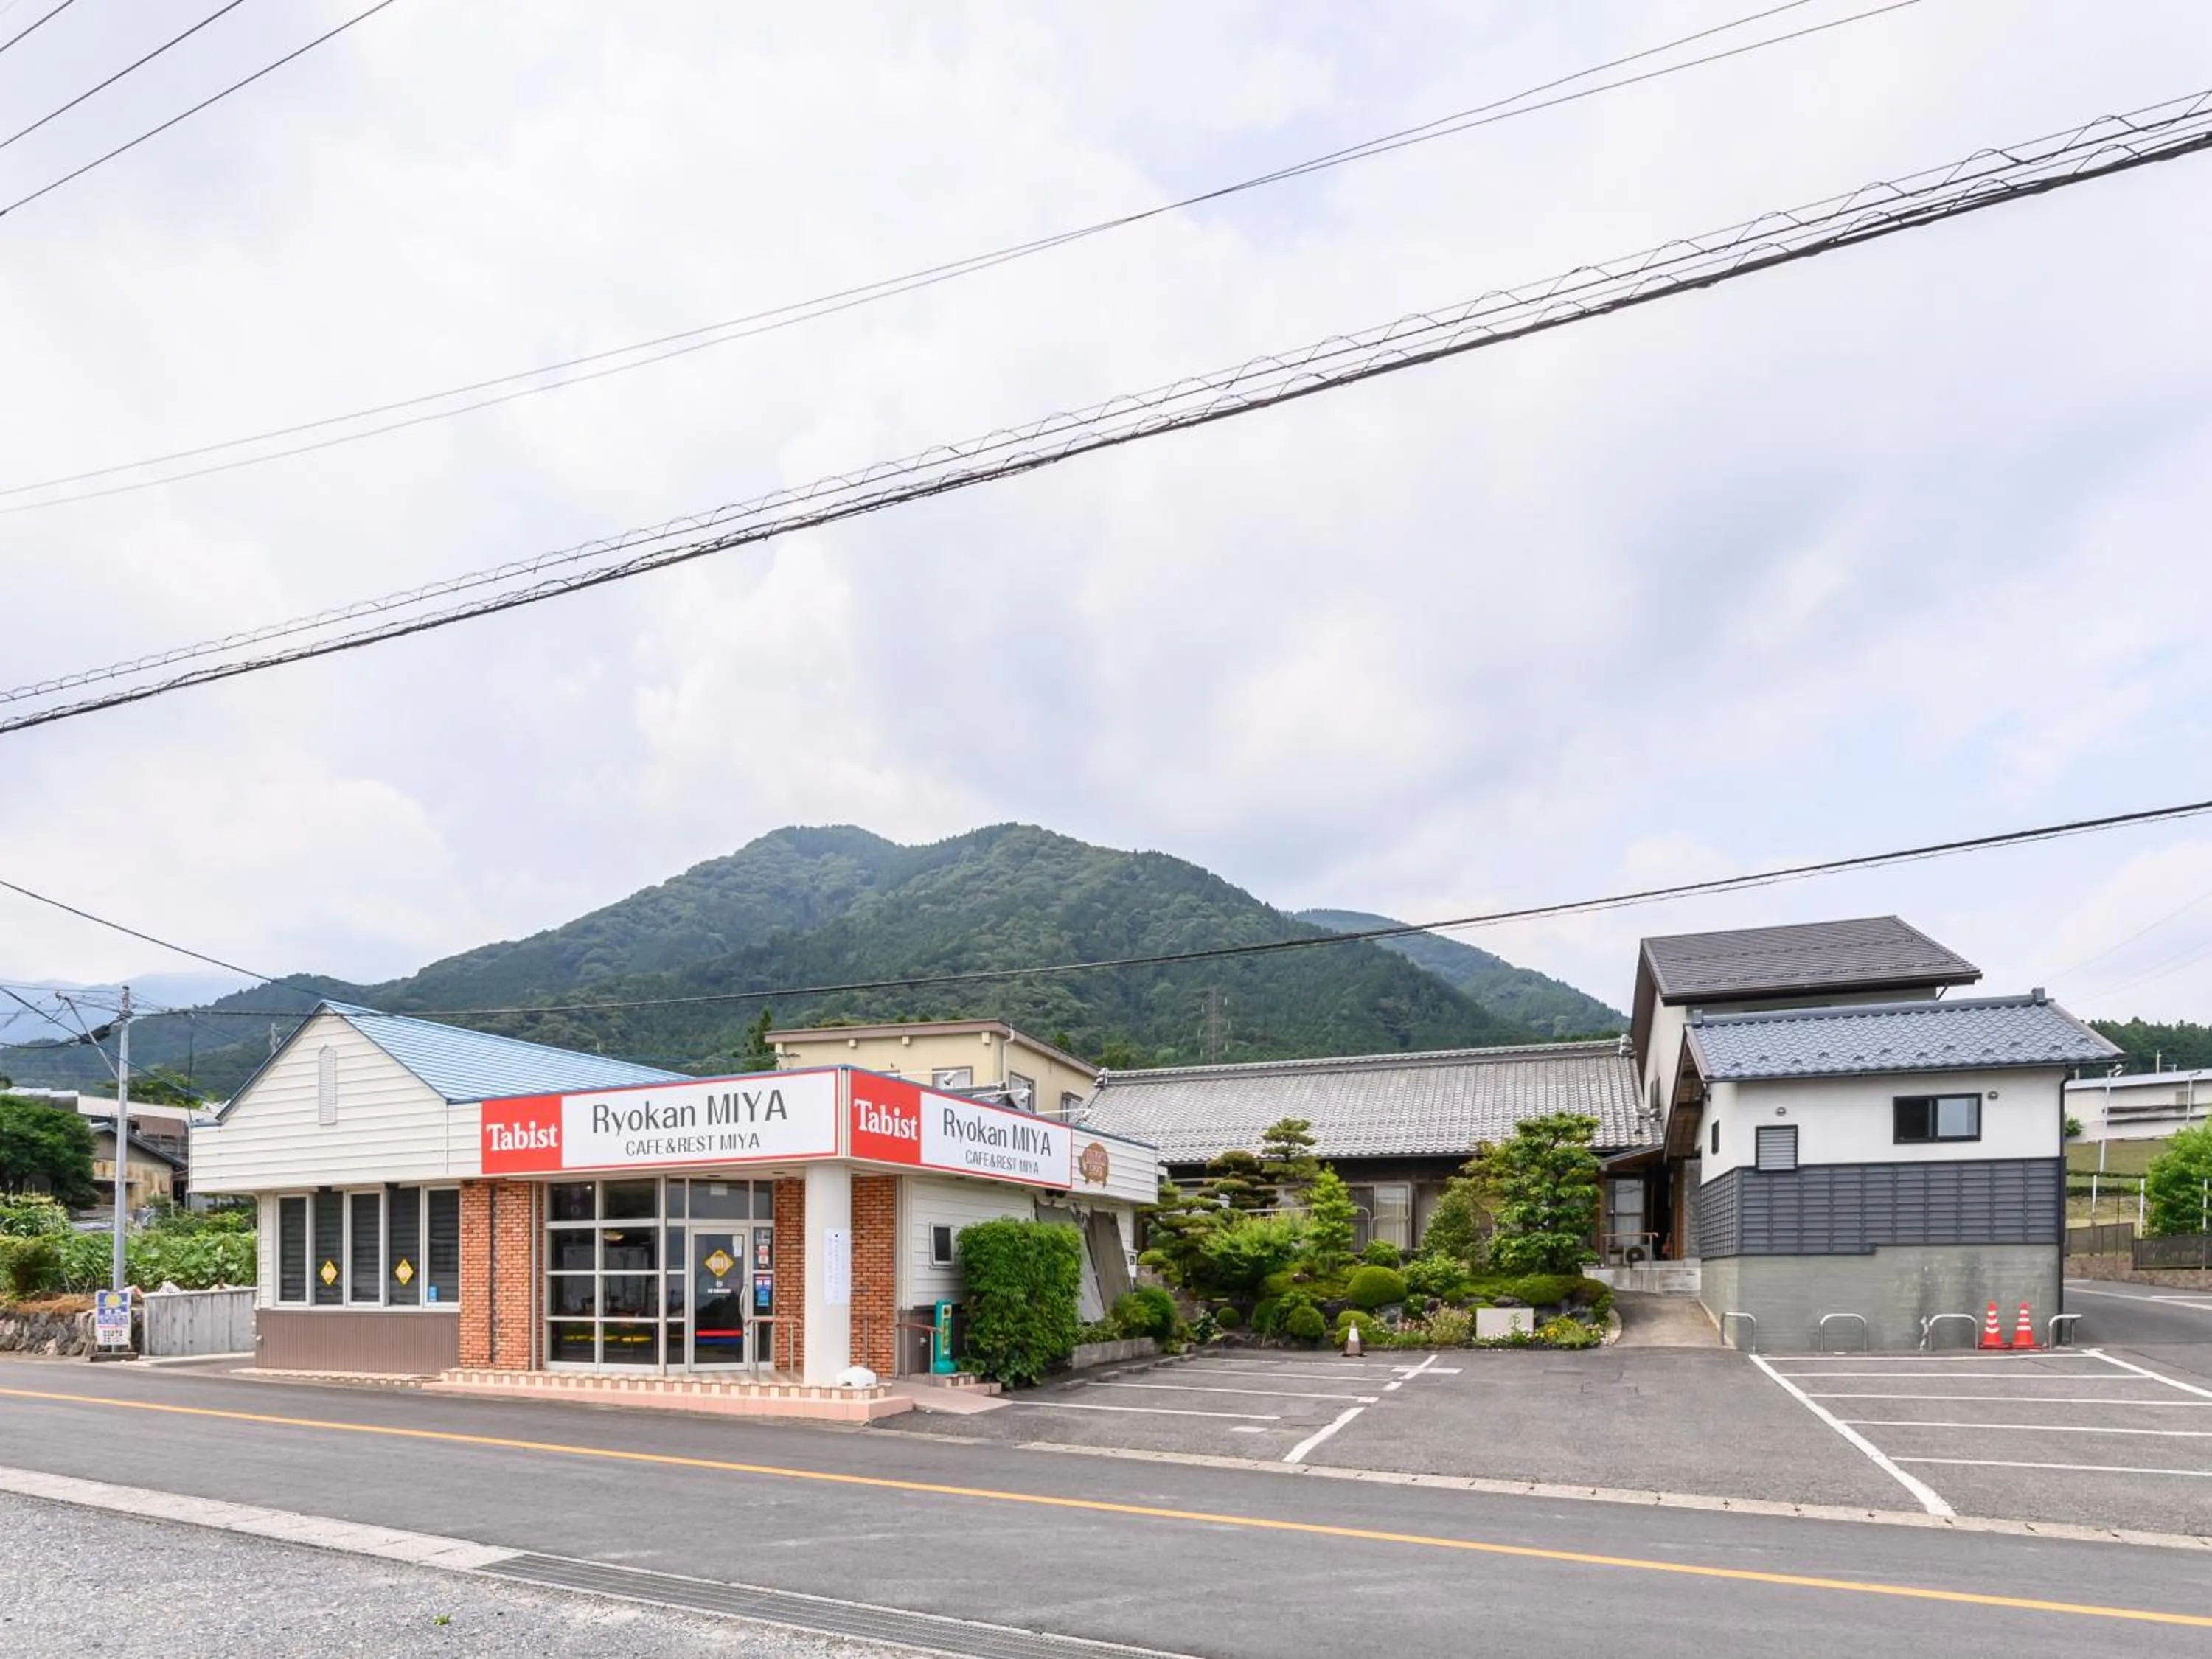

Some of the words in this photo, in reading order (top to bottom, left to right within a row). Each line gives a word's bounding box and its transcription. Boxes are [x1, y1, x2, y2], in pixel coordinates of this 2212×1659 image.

[592, 1100, 696, 1136] Ryokan
[706, 1089, 788, 1126] MIYA
[854, 1099, 918, 1141] Tabist
[486, 1120, 558, 1151] Tabist
[625, 1135, 715, 1156] CAFE&REST
[720, 1133, 760, 1150] MIYA
[943, 1107, 1007, 1147] Ryokan
[1012, 1124, 1051, 1157] MIYA
[965, 1150, 1017, 1171] CAFE&REST
[1019, 1161, 1039, 1175] MIYA
